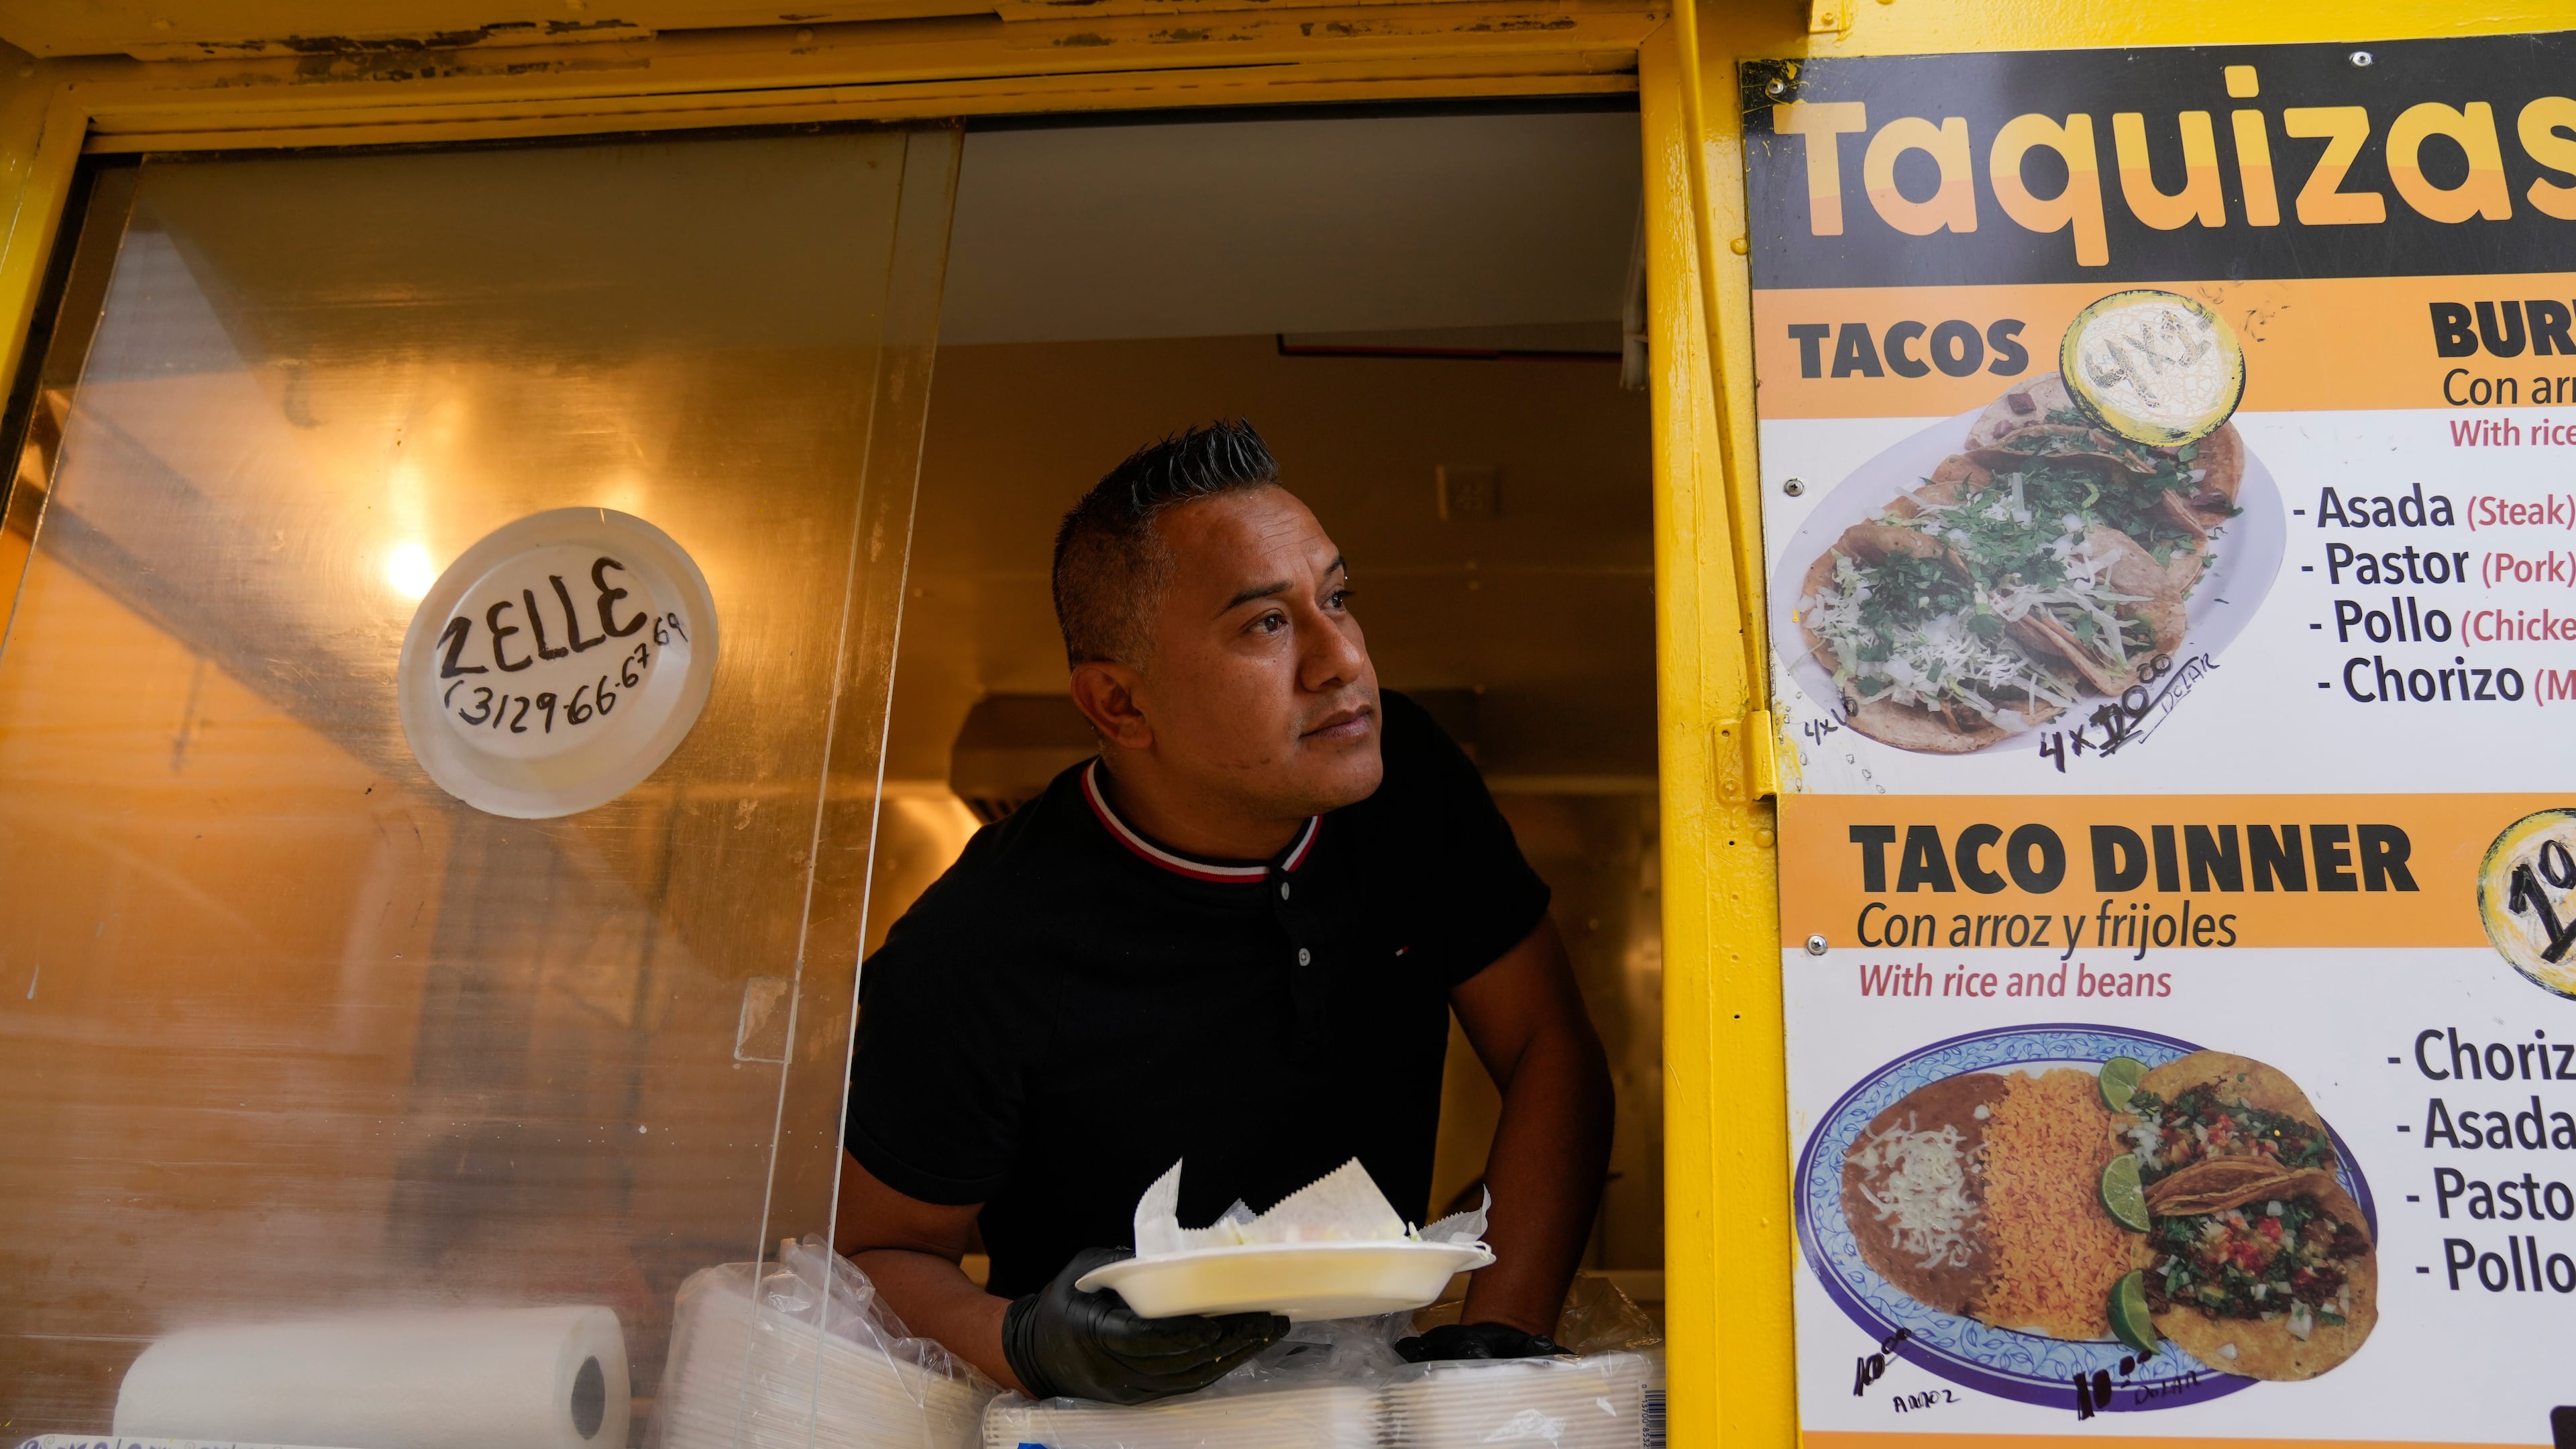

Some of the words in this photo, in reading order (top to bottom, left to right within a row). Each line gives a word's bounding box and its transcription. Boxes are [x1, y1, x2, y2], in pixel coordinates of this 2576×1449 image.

[1773, 65, 2576, 267] Taquizas
[1788, 319, 2029, 378] TACOS
[2429, 299, 2576, 358] BUR
[2443, 368, 2518, 406] Con
[2450, 418, 2520, 447] With
[2531, 418, 2576, 445] rice
[2317, 483, 2455, 527] Asada
[2467, 494, 2576, 532] (Steak)
[2325, 543, 2469, 584] Pastor
[2482, 551, 2576, 589] (Pork)
[437, 557, 648, 678] ZELLE
[2334, 596, 2452, 643] Pollo
[2461, 608, 2576, 647] (Chicke
[2343, 655, 2524, 702] Chorizo
[2534, 668, 2576, 707] (M
[1849, 824, 2066, 894] TACO
[2090, 824, 2420, 893] DINNER
[1858, 902, 1937, 948] Con
[1949, 914, 2051, 948] arroz
[2061, 915, 2086, 961] y
[2096, 899, 2237, 961] frijoles
[1860, 963, 1933, 997] With
[1943, 964, 1998, 998] rice
[2006, 963, 2068, 998] and
[2076, 963, 2172, 998] beans
[2415, 1027, 2576, 1081] Choriz
[2424, 1095, 2576, 1150] Asada
[2433, 1167, 2575, 1221] Pasto
[2443, 1235, 2576, 1293] Pollo
